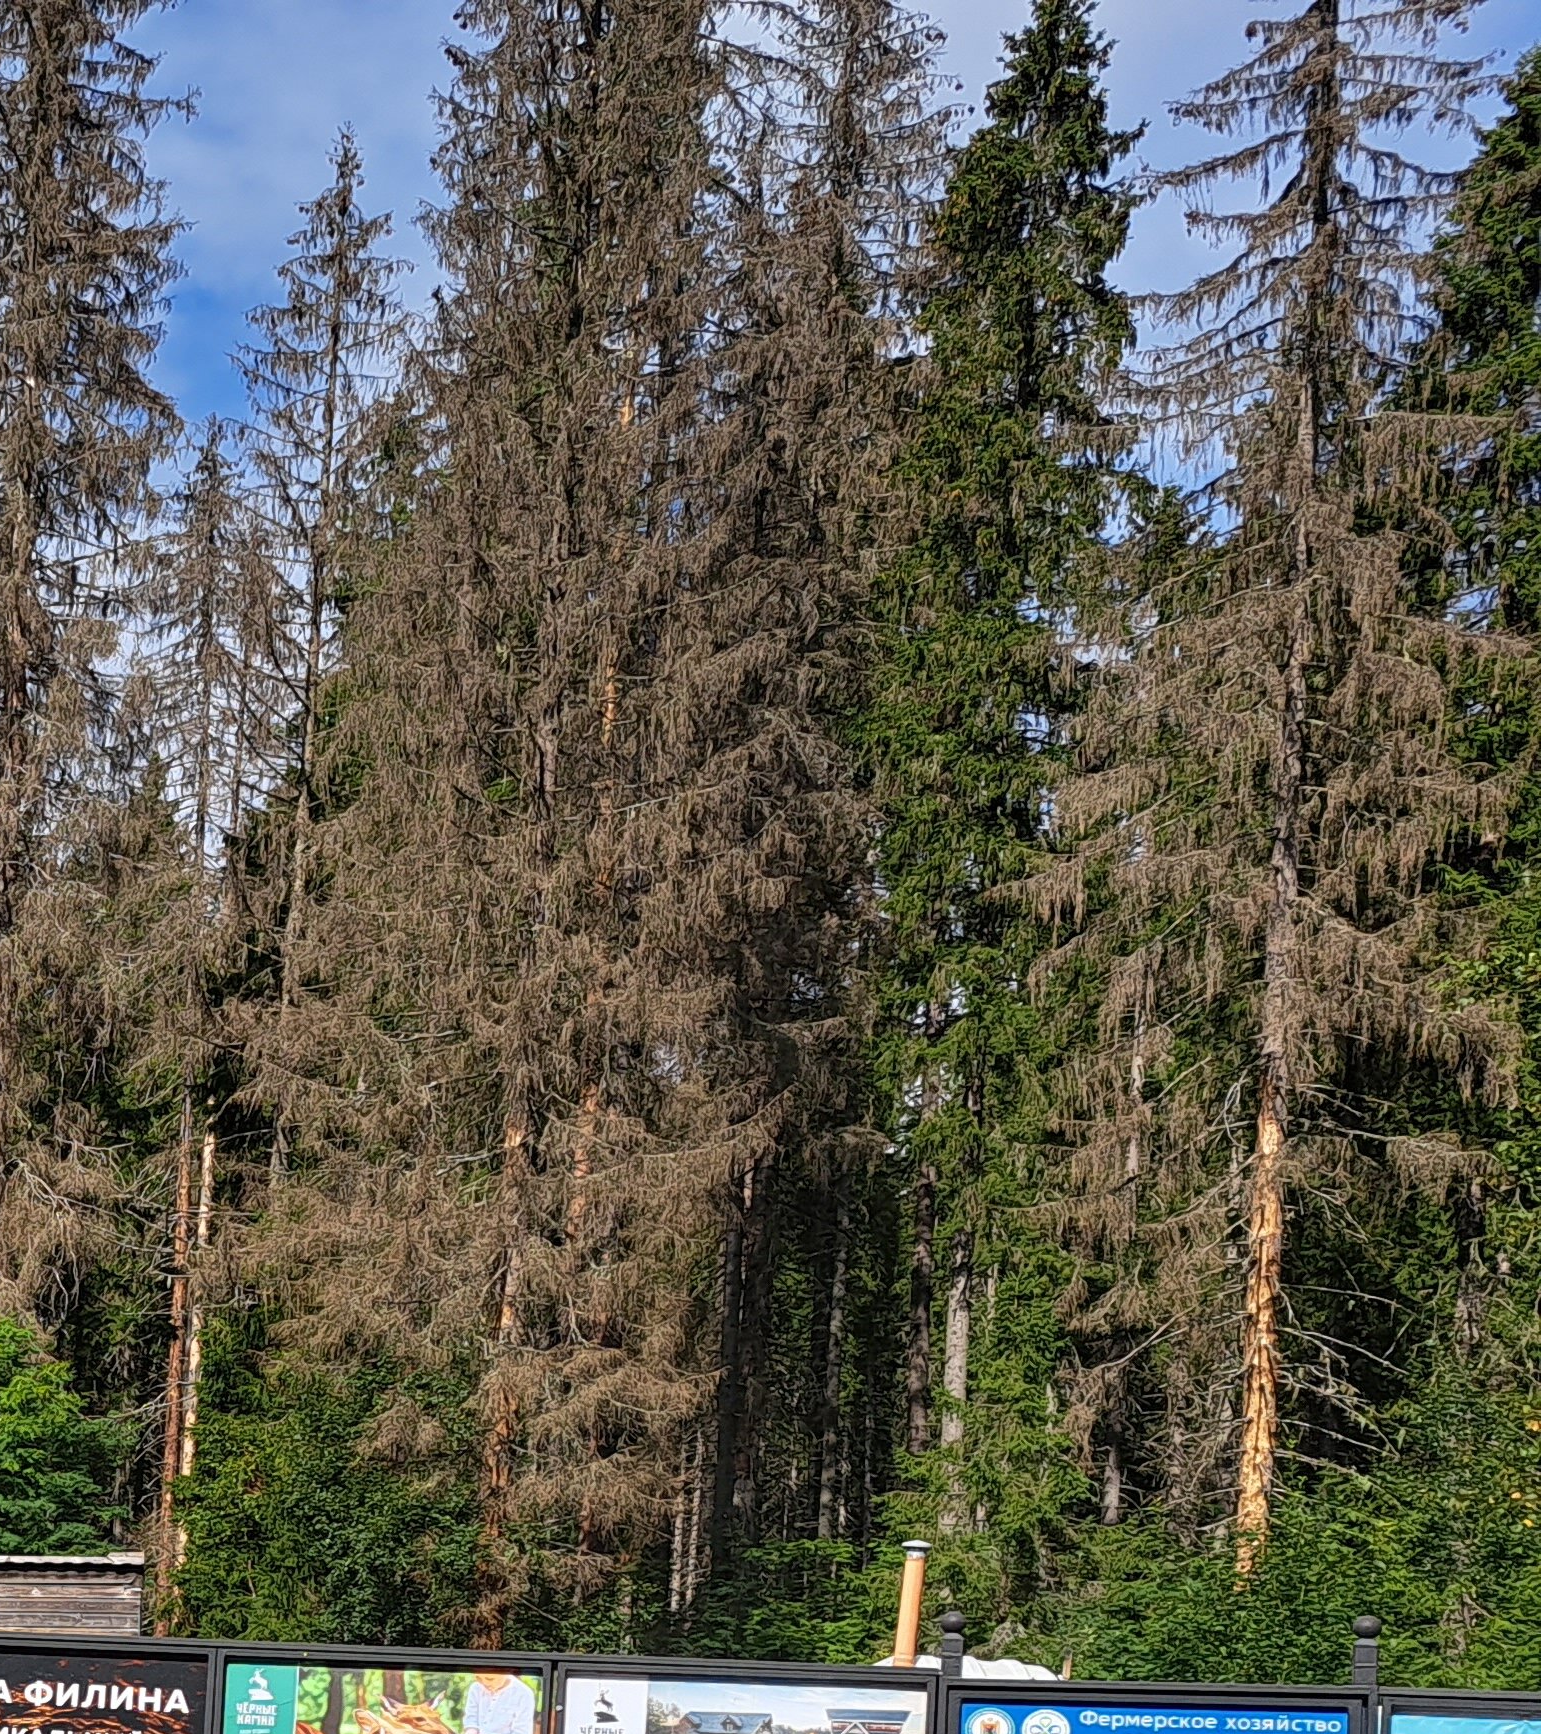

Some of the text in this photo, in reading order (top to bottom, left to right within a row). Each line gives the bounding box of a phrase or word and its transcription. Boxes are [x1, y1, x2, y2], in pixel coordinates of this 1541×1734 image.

[23, 1680, 190, 1714] ФИЛИНА
[1079, 1710, 1342, 1733] Фермерское хозяйство
